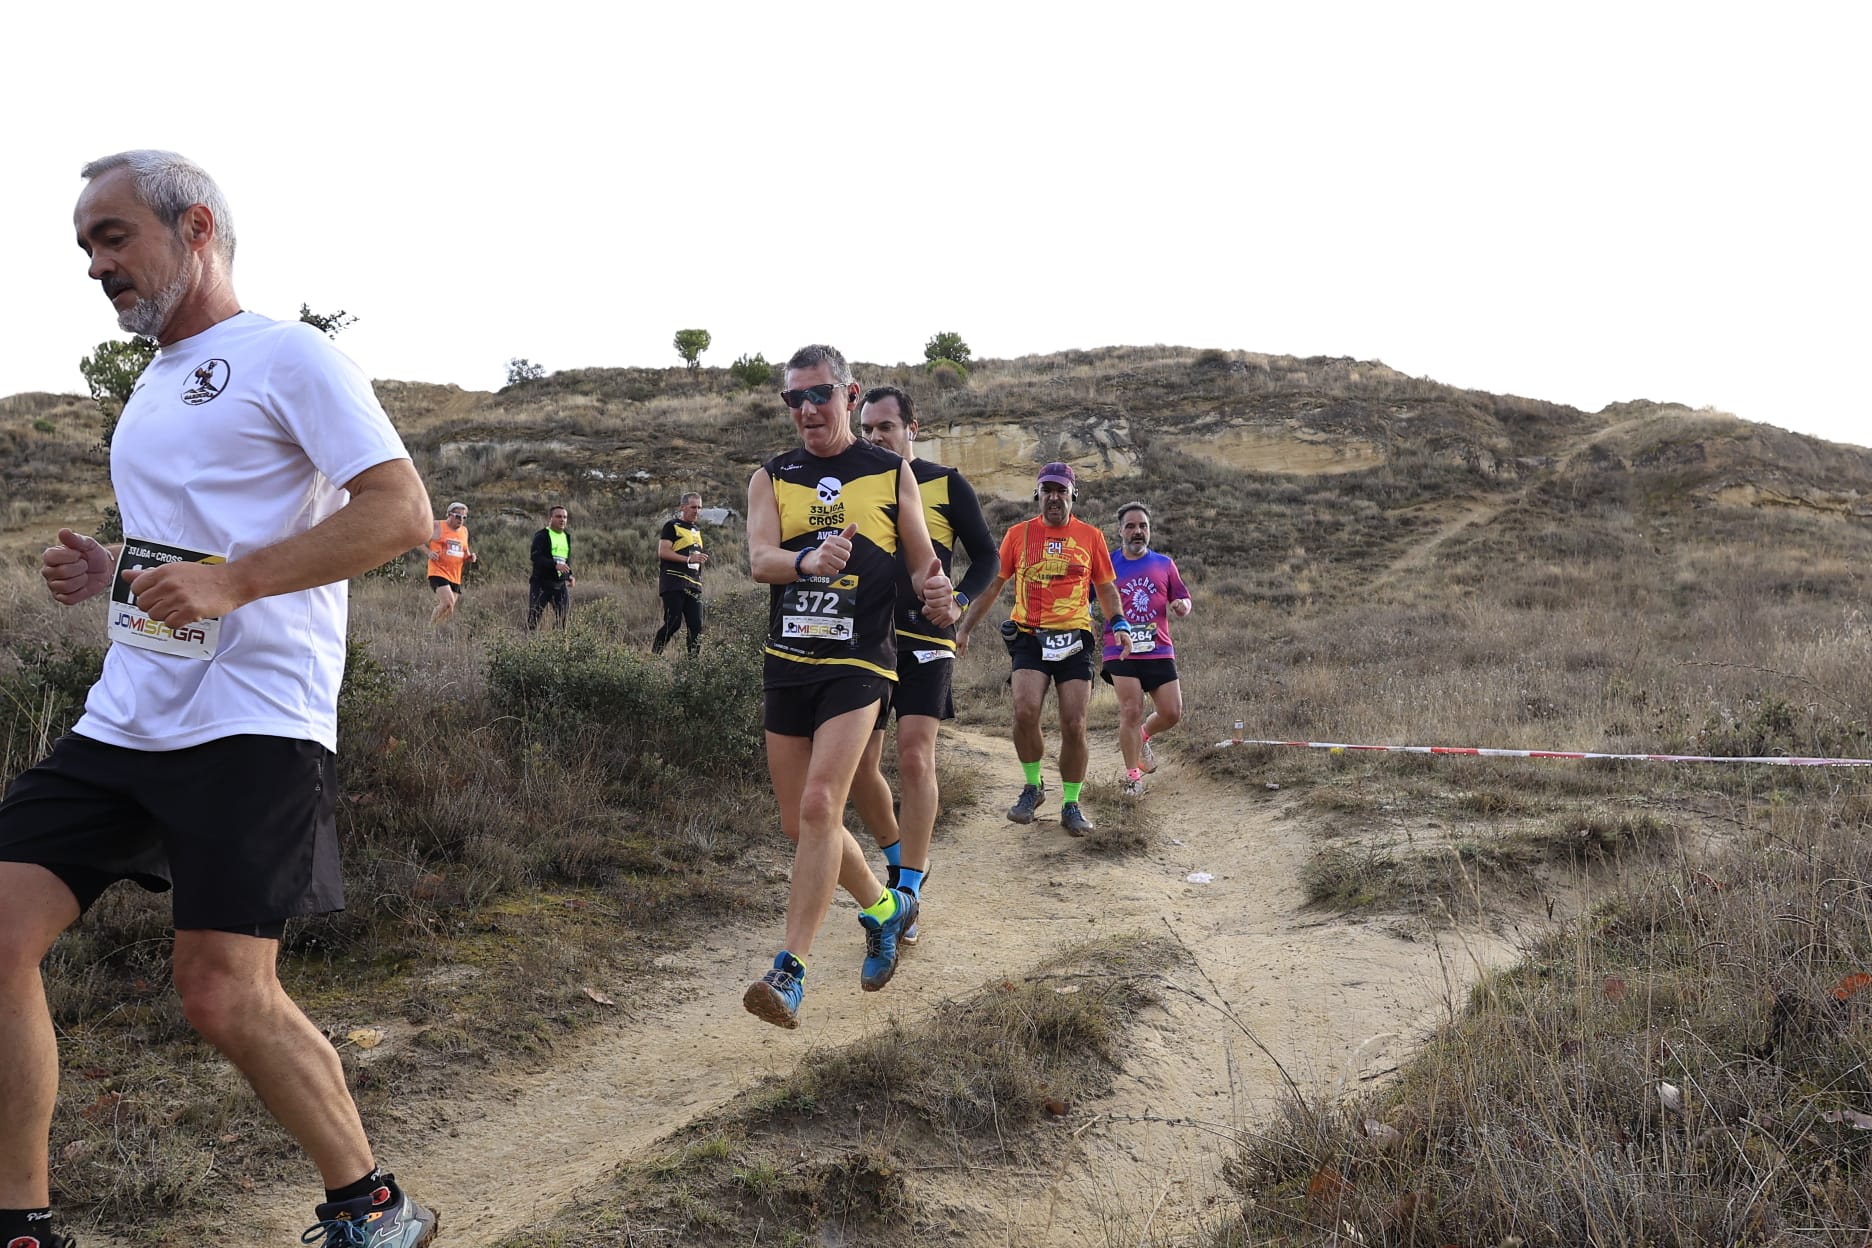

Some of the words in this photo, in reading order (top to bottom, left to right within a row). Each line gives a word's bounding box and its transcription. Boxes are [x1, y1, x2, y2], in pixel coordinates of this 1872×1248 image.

[809, 513, 845, 526] CROSS
[136, 548, 151, 559] LIGA
[1047, 541, 1063, 554] 24
[795, 591, 840, 615] 372
[114, 612, 206, 645] JOMISAGA
[1046, 633, 1073, 648] 437
[1130, 631, 1152, 642] 264
